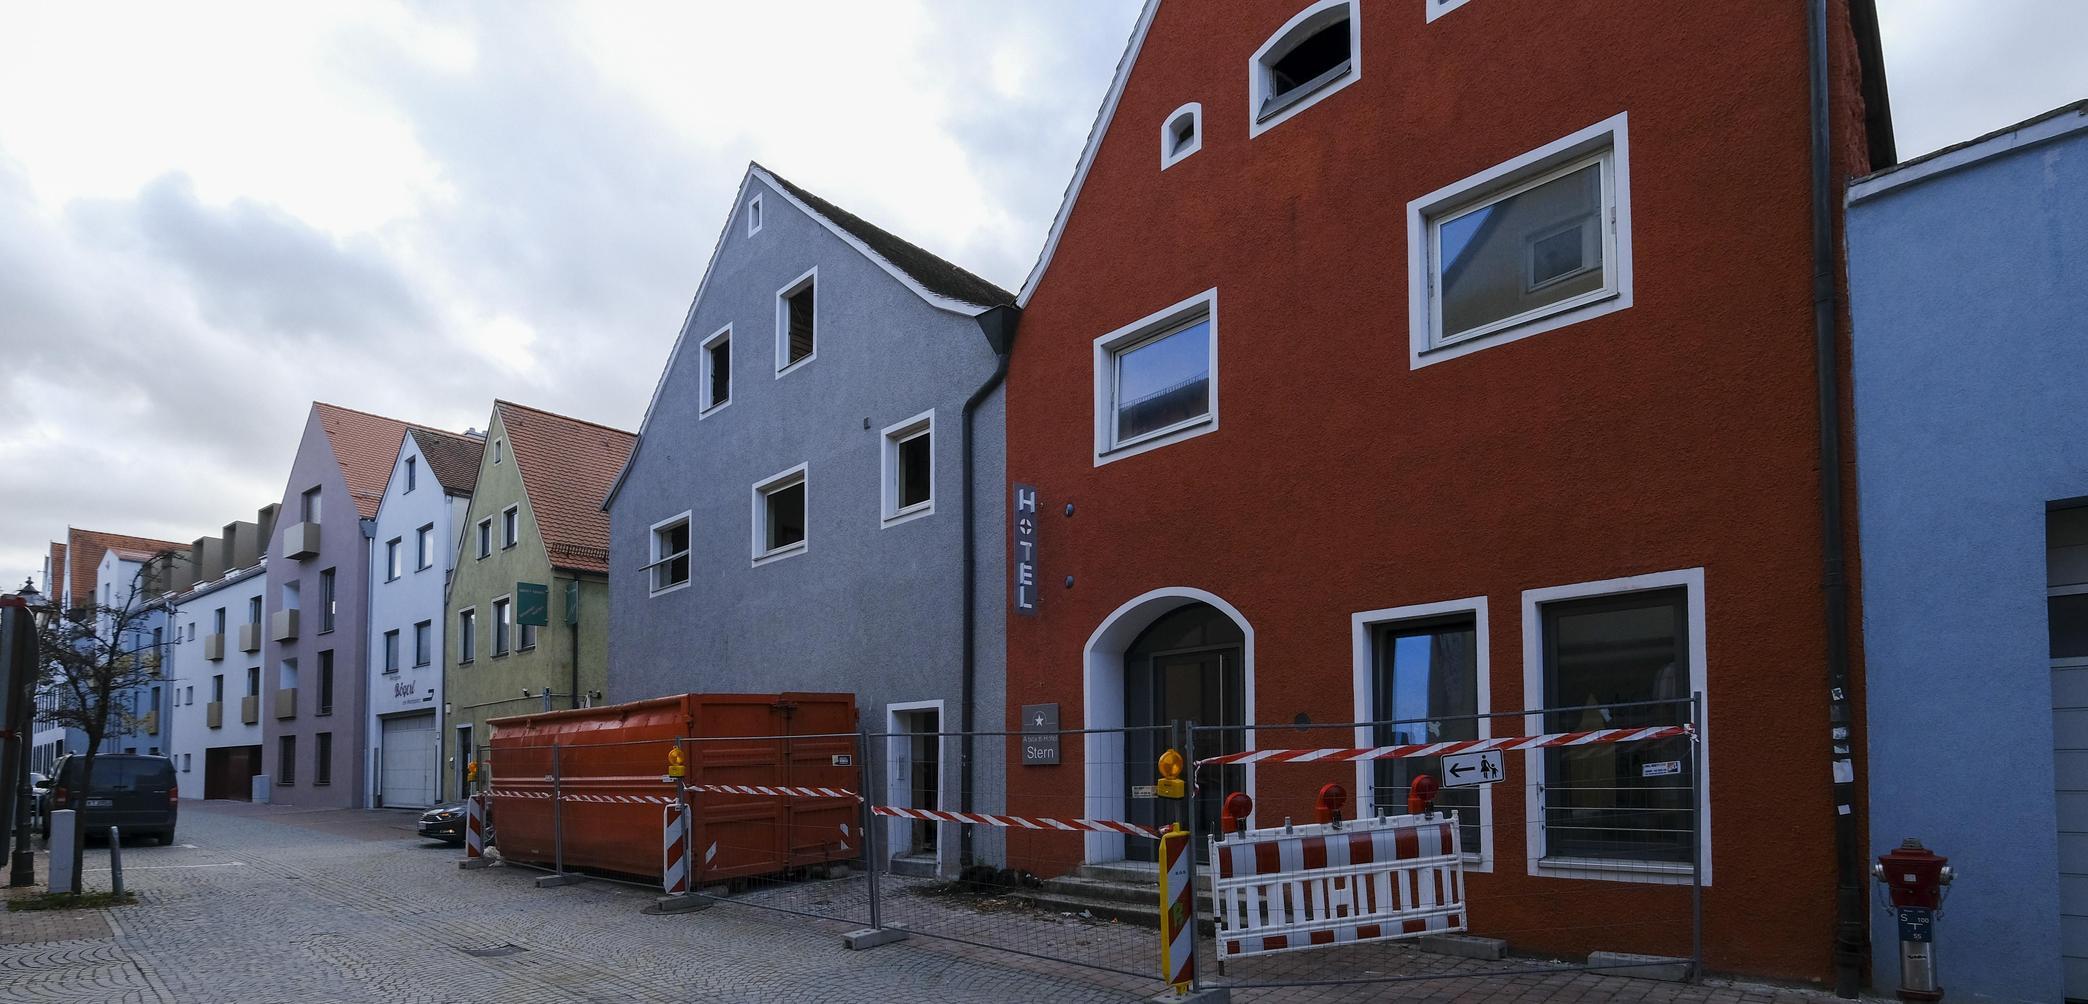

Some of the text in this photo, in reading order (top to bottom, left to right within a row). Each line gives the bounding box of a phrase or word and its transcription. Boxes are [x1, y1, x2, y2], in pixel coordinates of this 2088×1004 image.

[1018, 488, 1036, 608] HOTEL
[1027, 746, 1054, 759] Stern
[1901, 913, 1908, 921] S
